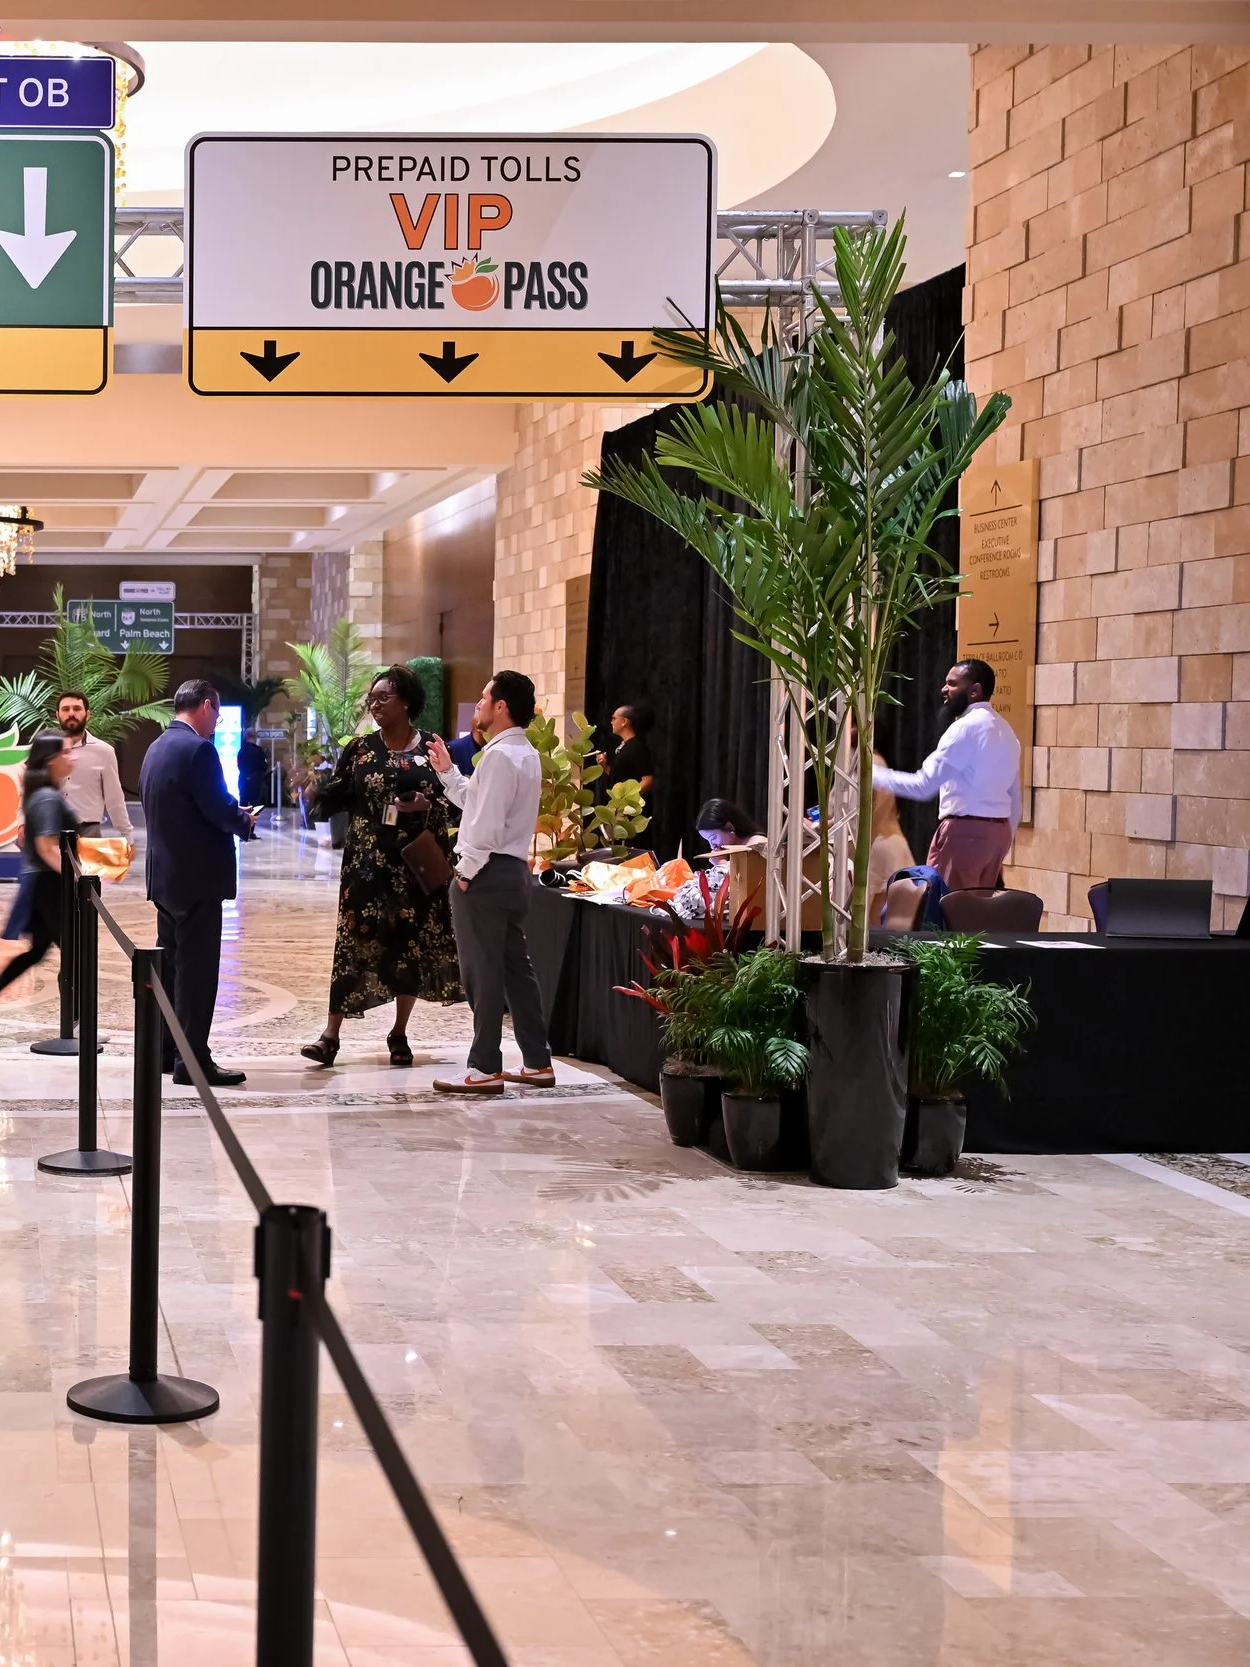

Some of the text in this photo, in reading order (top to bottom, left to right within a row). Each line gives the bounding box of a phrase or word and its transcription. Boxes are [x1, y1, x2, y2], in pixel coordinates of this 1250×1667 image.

[18, 77, 70, 108] OB
[331, 155, 581, 183] PREPAID TOLLS
[389, 192, 513, 251] VIP
[310, 260, 589, 310] ORANGE PASS
[974, 516, 1018, 533] BUSINESS CENTER
[981, 535, 1010, 549] EXECUTIVE
[969, 547, 1021, 566] CONFERENCE ROOMS
[980, 567, 1010, 580] RESTROOMS
[139, 608, 161, 616] North
[119, 629, 142, 638] Palm
[143, 629, 170, 638] Beach
